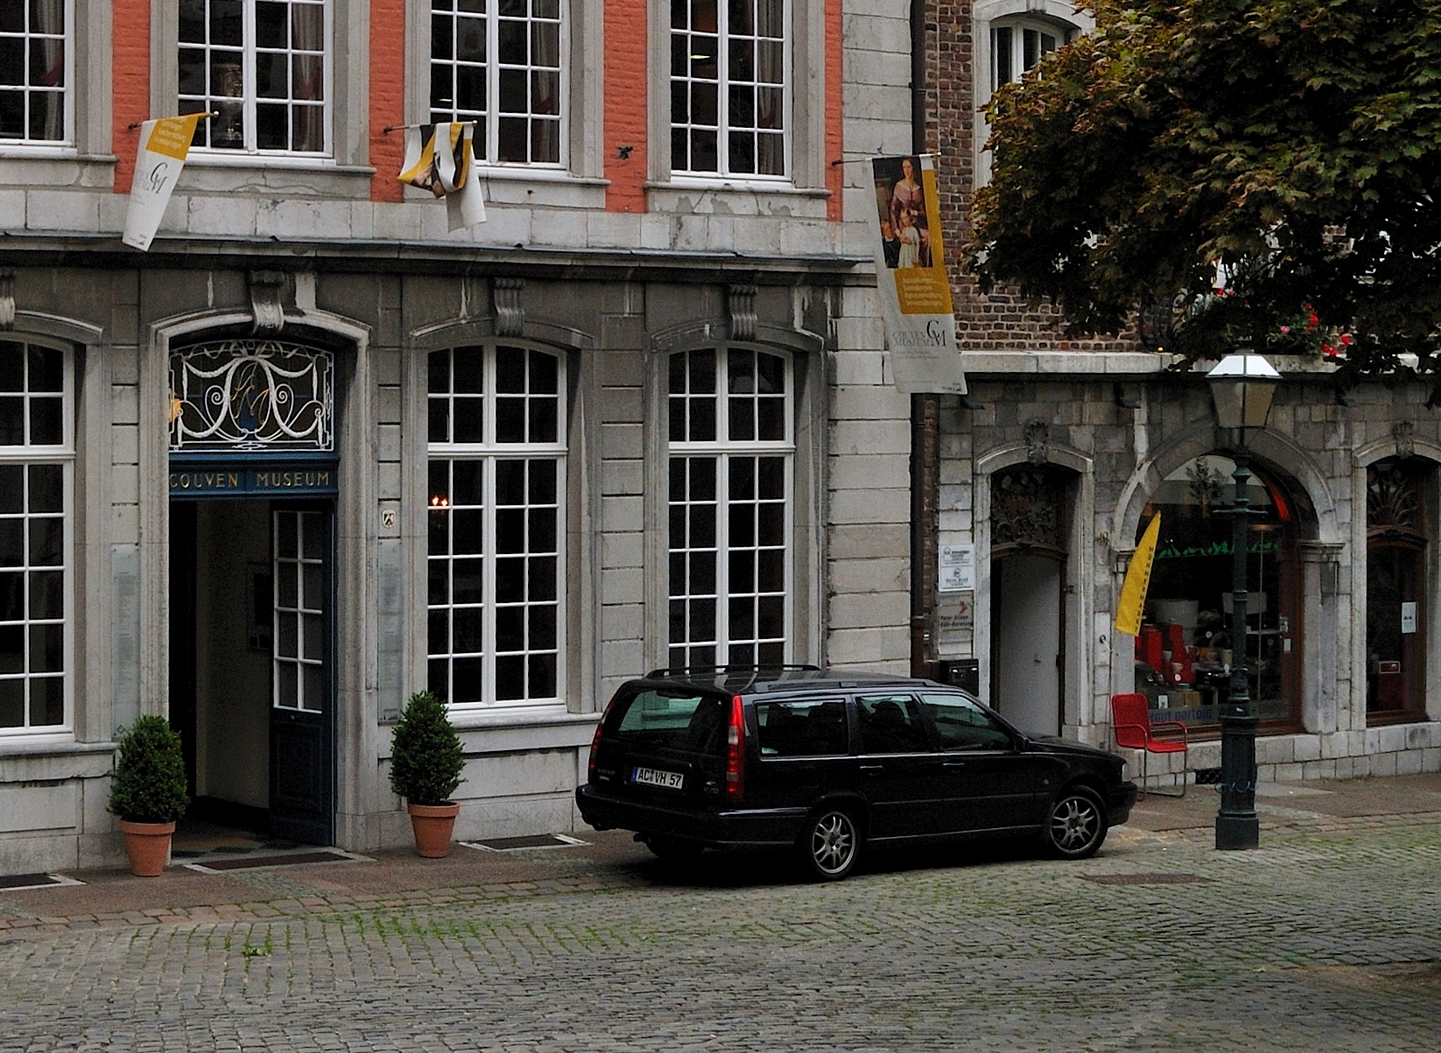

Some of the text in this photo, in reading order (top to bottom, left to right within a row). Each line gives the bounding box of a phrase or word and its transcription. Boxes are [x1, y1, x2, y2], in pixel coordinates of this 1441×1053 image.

[169, 472, 330, 489] COUVEN MUSEUM
[637, 769, 682, 787] AC VH 57
